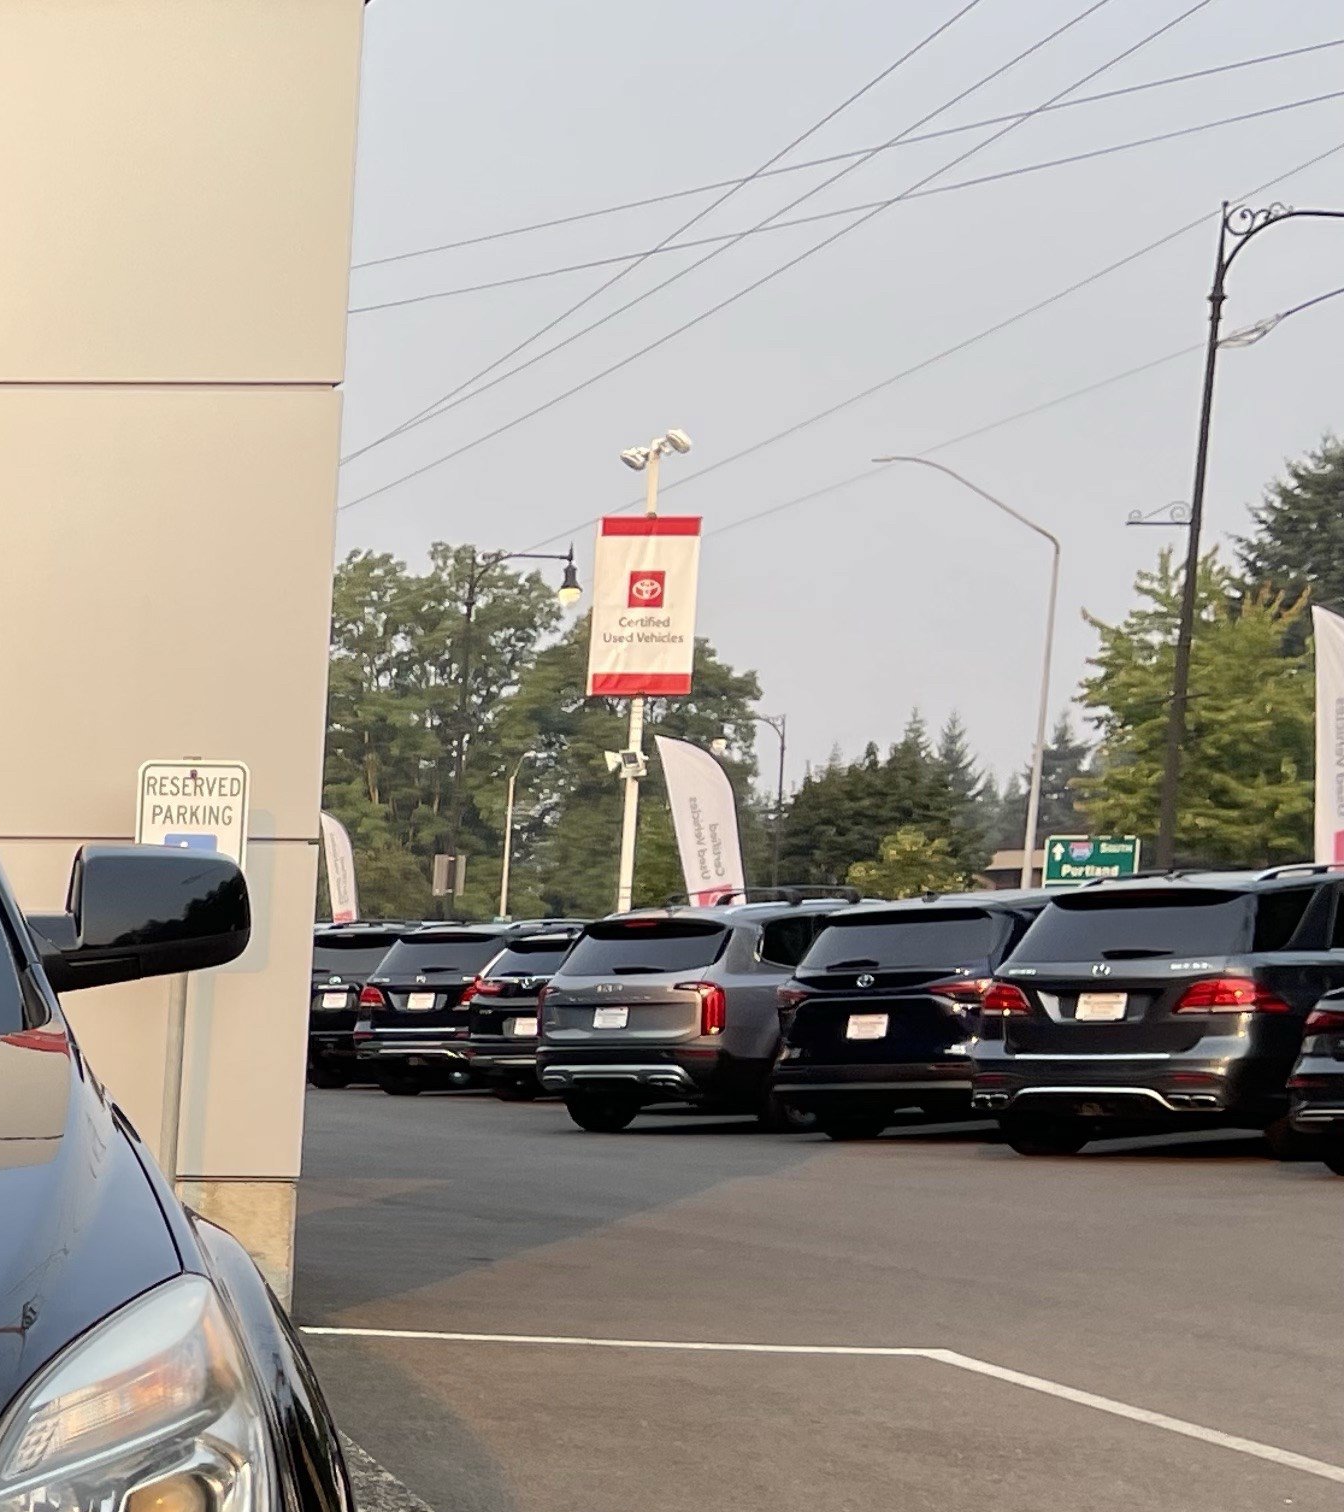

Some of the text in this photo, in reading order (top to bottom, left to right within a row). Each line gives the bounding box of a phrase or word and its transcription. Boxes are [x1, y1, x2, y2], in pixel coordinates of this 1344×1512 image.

[618, 616, 670, 628] Certified
[603, 632, 684, 643] Used Vehicles
[147, 776, 241, 797] RESERVED
[152, 805, 233, 826] PARKING
[1060, 863, 1120, 878] Portland
